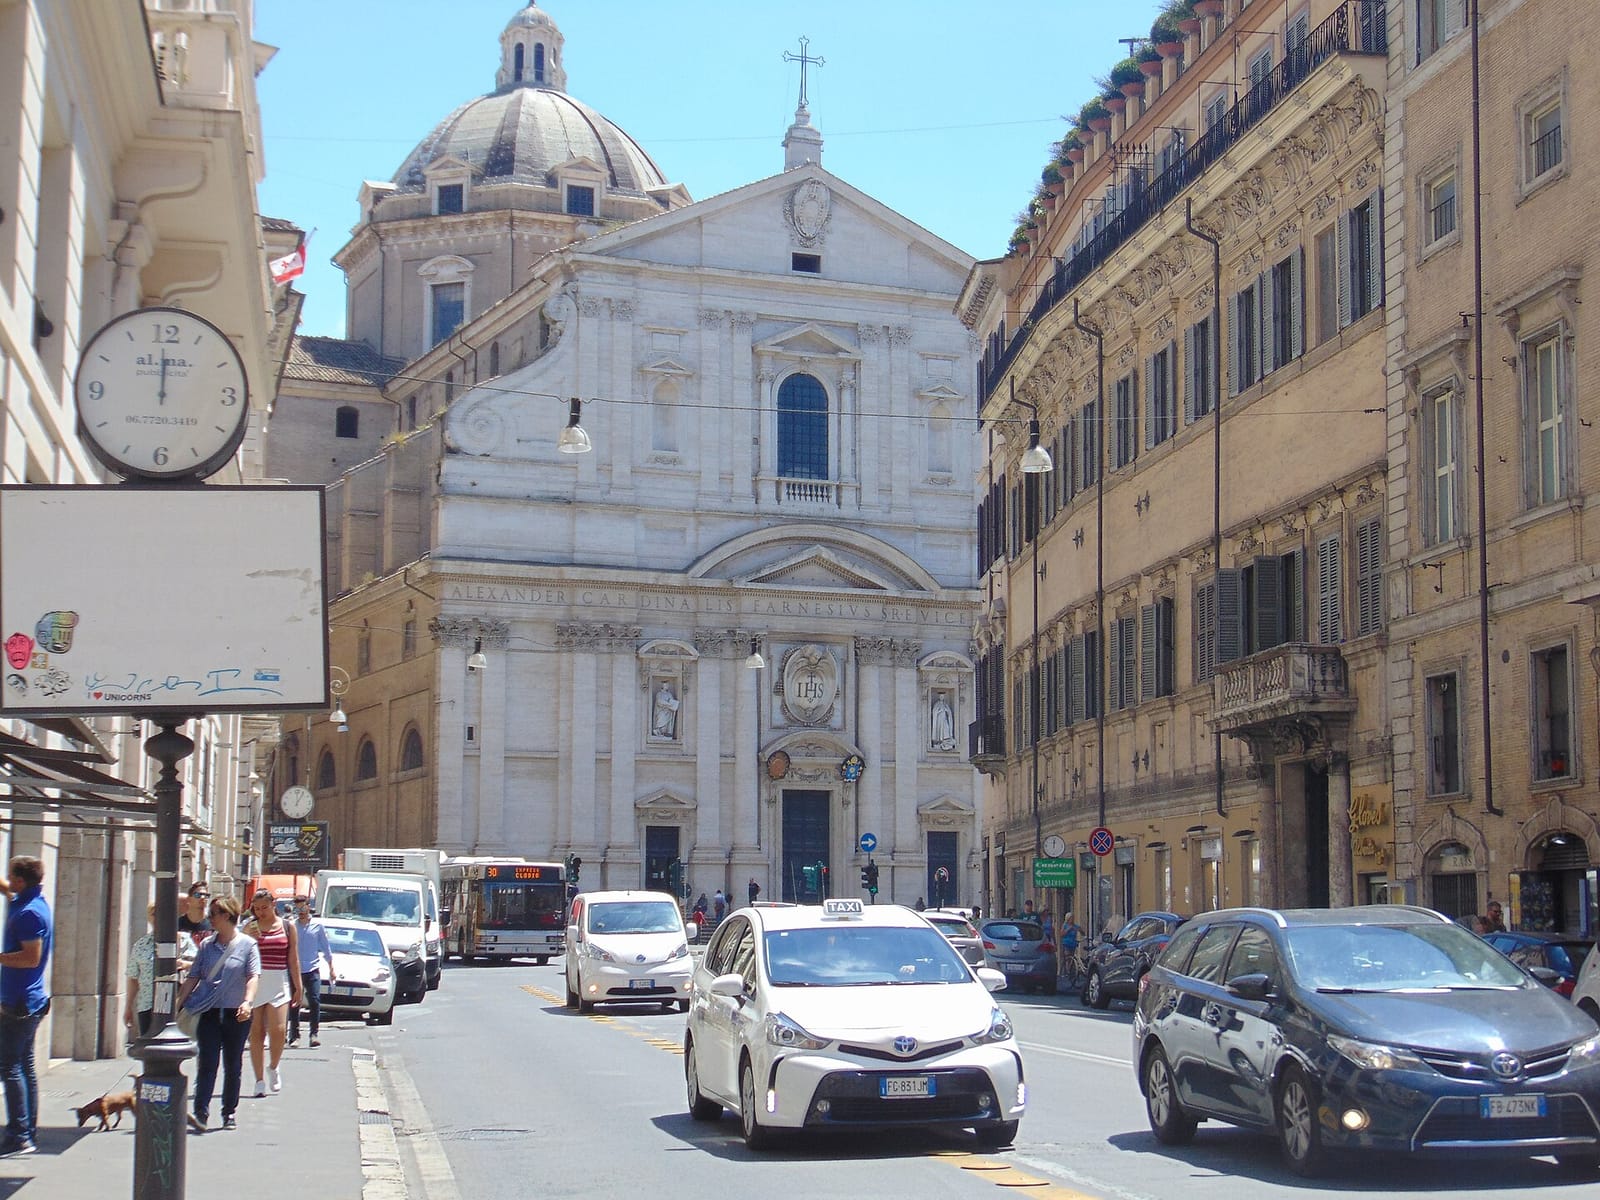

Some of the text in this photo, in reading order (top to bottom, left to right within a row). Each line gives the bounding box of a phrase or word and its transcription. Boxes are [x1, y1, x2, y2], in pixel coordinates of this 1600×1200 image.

[152, 324, 180, 344] 12
[88, 380, 104, 400] 9
[220, 386, 237, 406] 3
[153, 446, 169, 466] 6
[452, 586, 566, 603] ALEXANDER
[104, 693, 152, 701] UNICORNS
[797, 682, 824, 699] IHS
[487, 867, 497, 877] 30
[828, 902, 860, 912] TAXI
